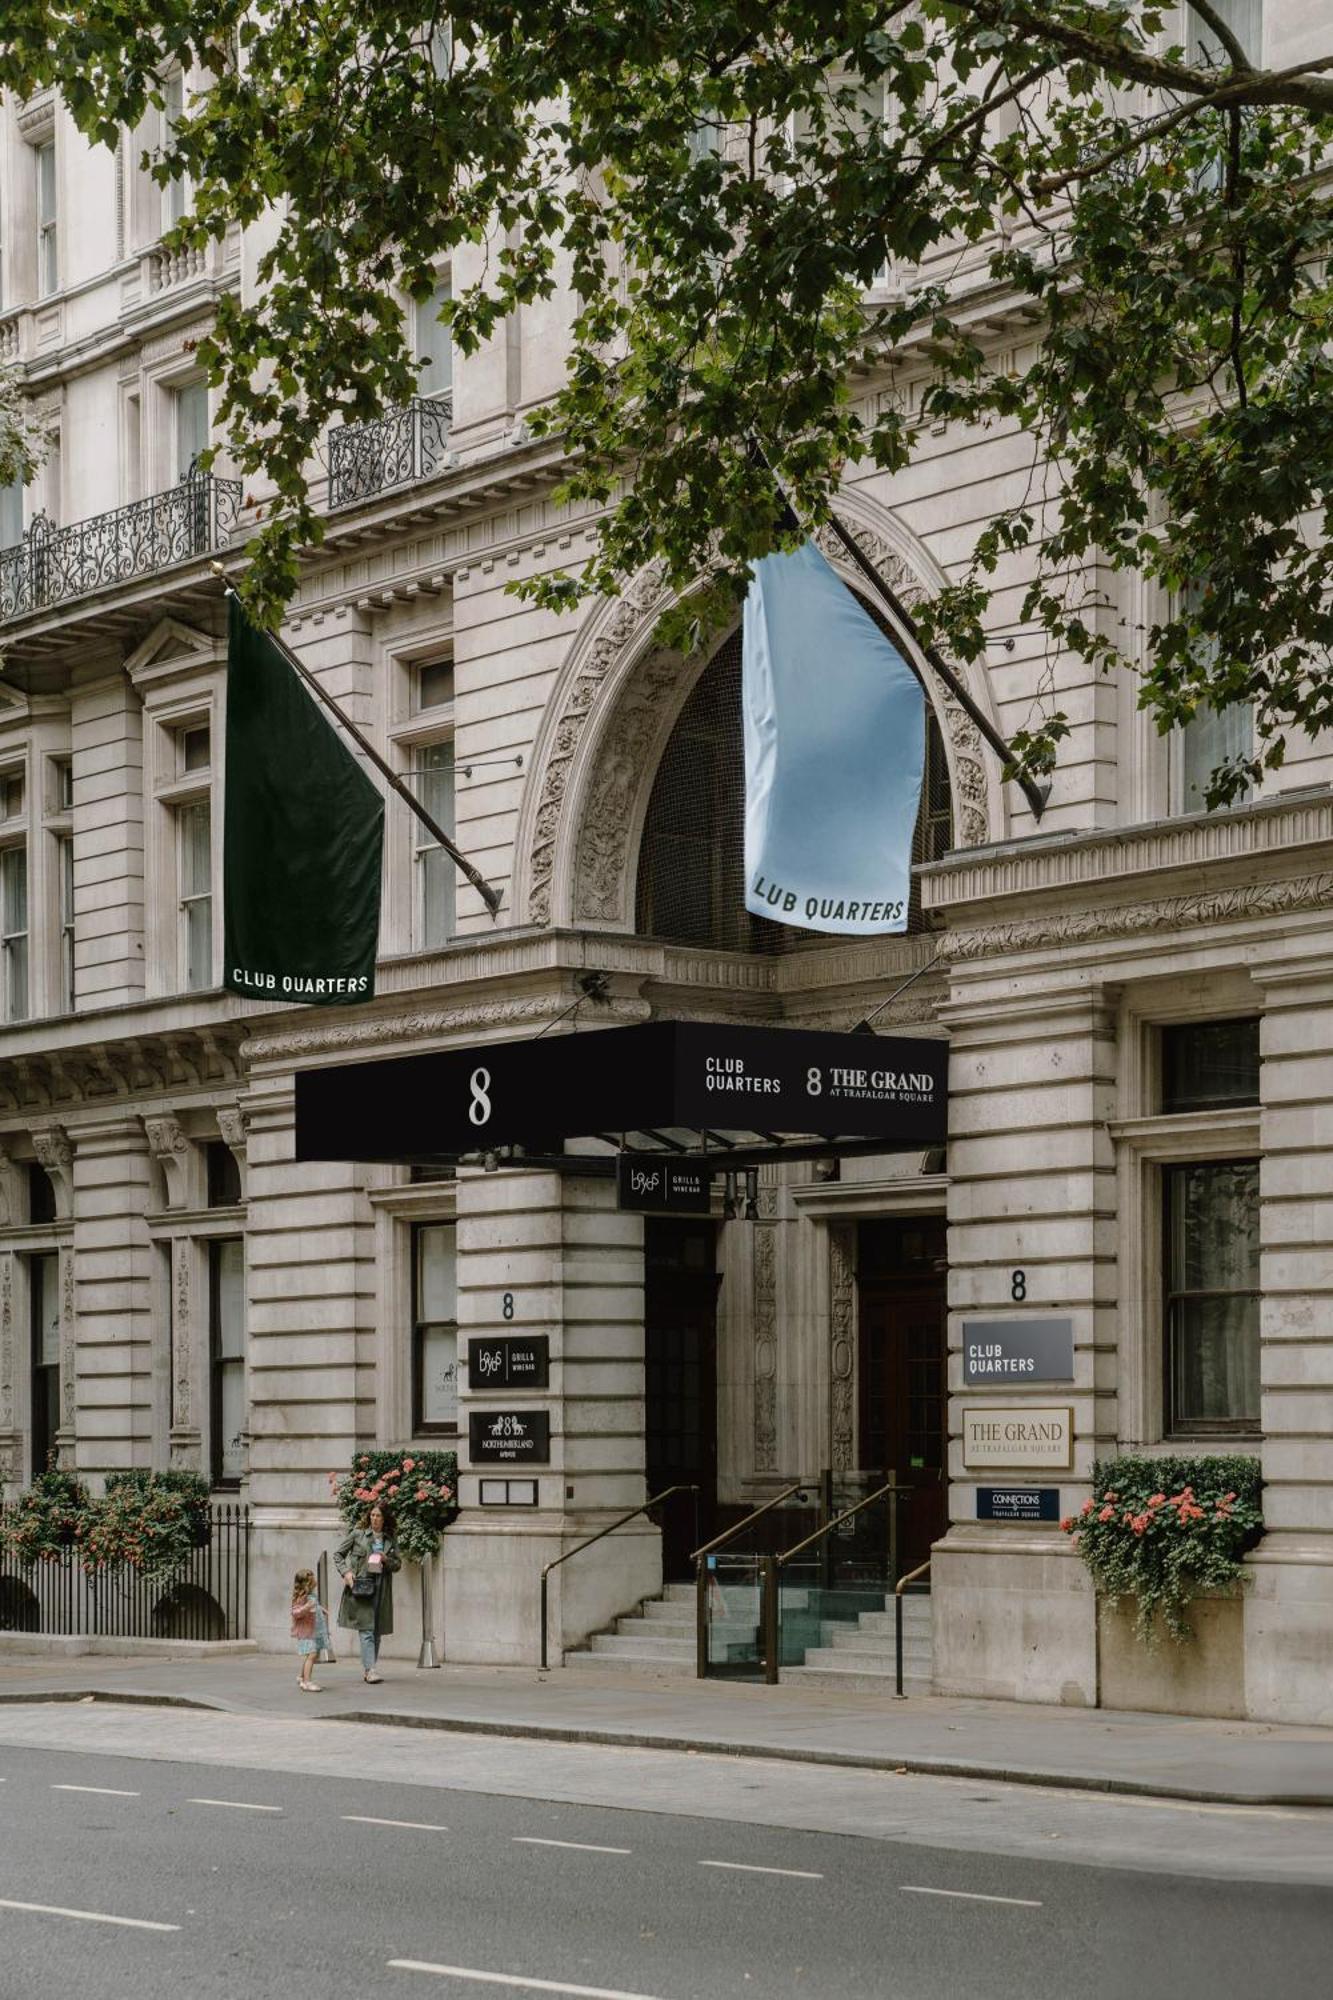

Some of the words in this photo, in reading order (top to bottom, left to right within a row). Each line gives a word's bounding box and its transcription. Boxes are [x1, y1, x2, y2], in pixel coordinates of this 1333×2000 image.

[753, 876, 798, 912] LUB
[805, 897, 904, 920] QUARTERS
[233, 968, 276, 989] CLUB
[282, 976, 368, 993] QUARTERS
[706, 1057, 744, 1074] CLUB
[706, 1075, 780, 1094] QUARTERS
[806, 1067, 822, 1096] 8
[829, 1068, 867, 1088] THE
[871, 1070, 934, 1091] GRAND
[469, 1067, 491, 1126] 8
[829, 1088, 841, 1097] AT
[843, 1088, 896, 1100] TRAFALGAR
[899, 1092, 934, 1102] SQUARE
[1011, 1270, 1026, 1301] 8
[503, 1293, 514, 1320] 8
[969, 1344, 1002, 1358] CLUB
[969, 1359, 1035, 1374] QUARTERS
[503, 1416, 512, 1436] 8
[970, 1423, 1000, 1441] THE
[1004, 1423, 1063, 1441] GRAND
[992, 1494, 1040, 1505] CONNECTIONS
